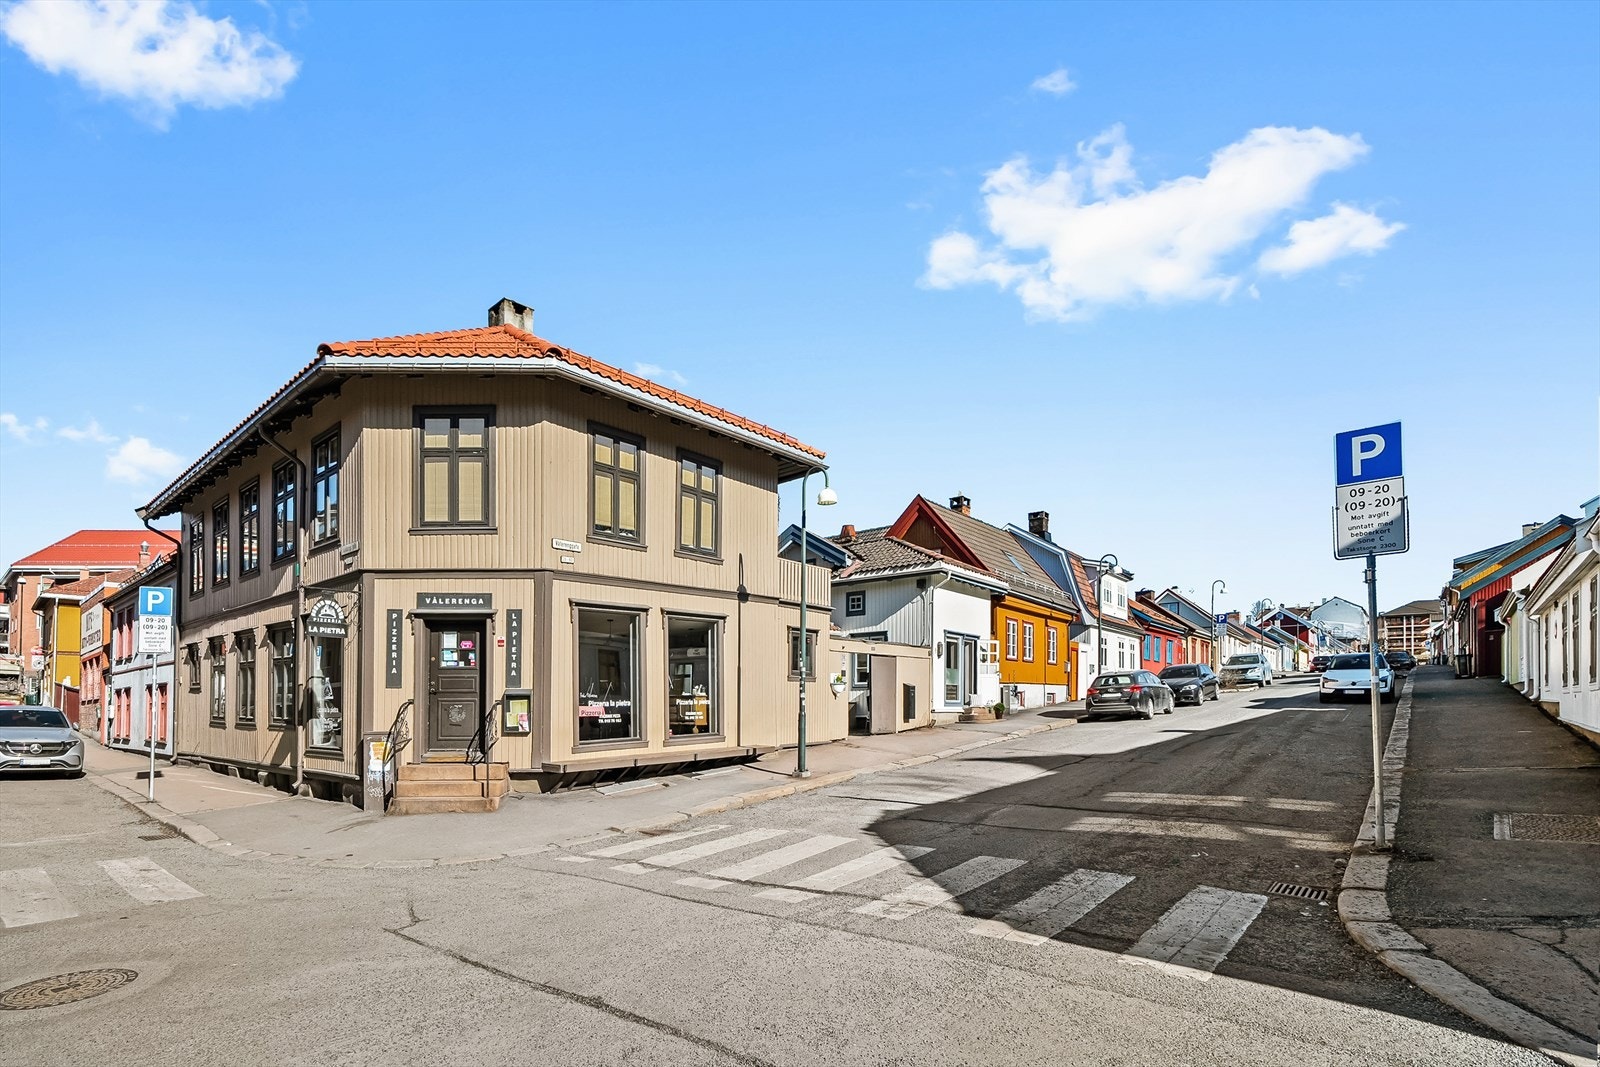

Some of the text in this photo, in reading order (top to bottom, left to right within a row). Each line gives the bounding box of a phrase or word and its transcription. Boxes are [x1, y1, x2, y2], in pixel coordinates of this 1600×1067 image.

[1351, 433, 1386, 477] P
[1367, 511, 1390, 519] avgift
[1347, 520, 1394, 531] unntatt med
[1350, 528, 1391, 538] beboerkort
[1346, 544, 1377, 553] Takstsone
[147, 591, 165, 612] P
[425, 597, 484, 605] VÅLERENGA
[308, 625, 346, 635] LA PIETRA
[510, 613, 518, 676] LA PIETRA
